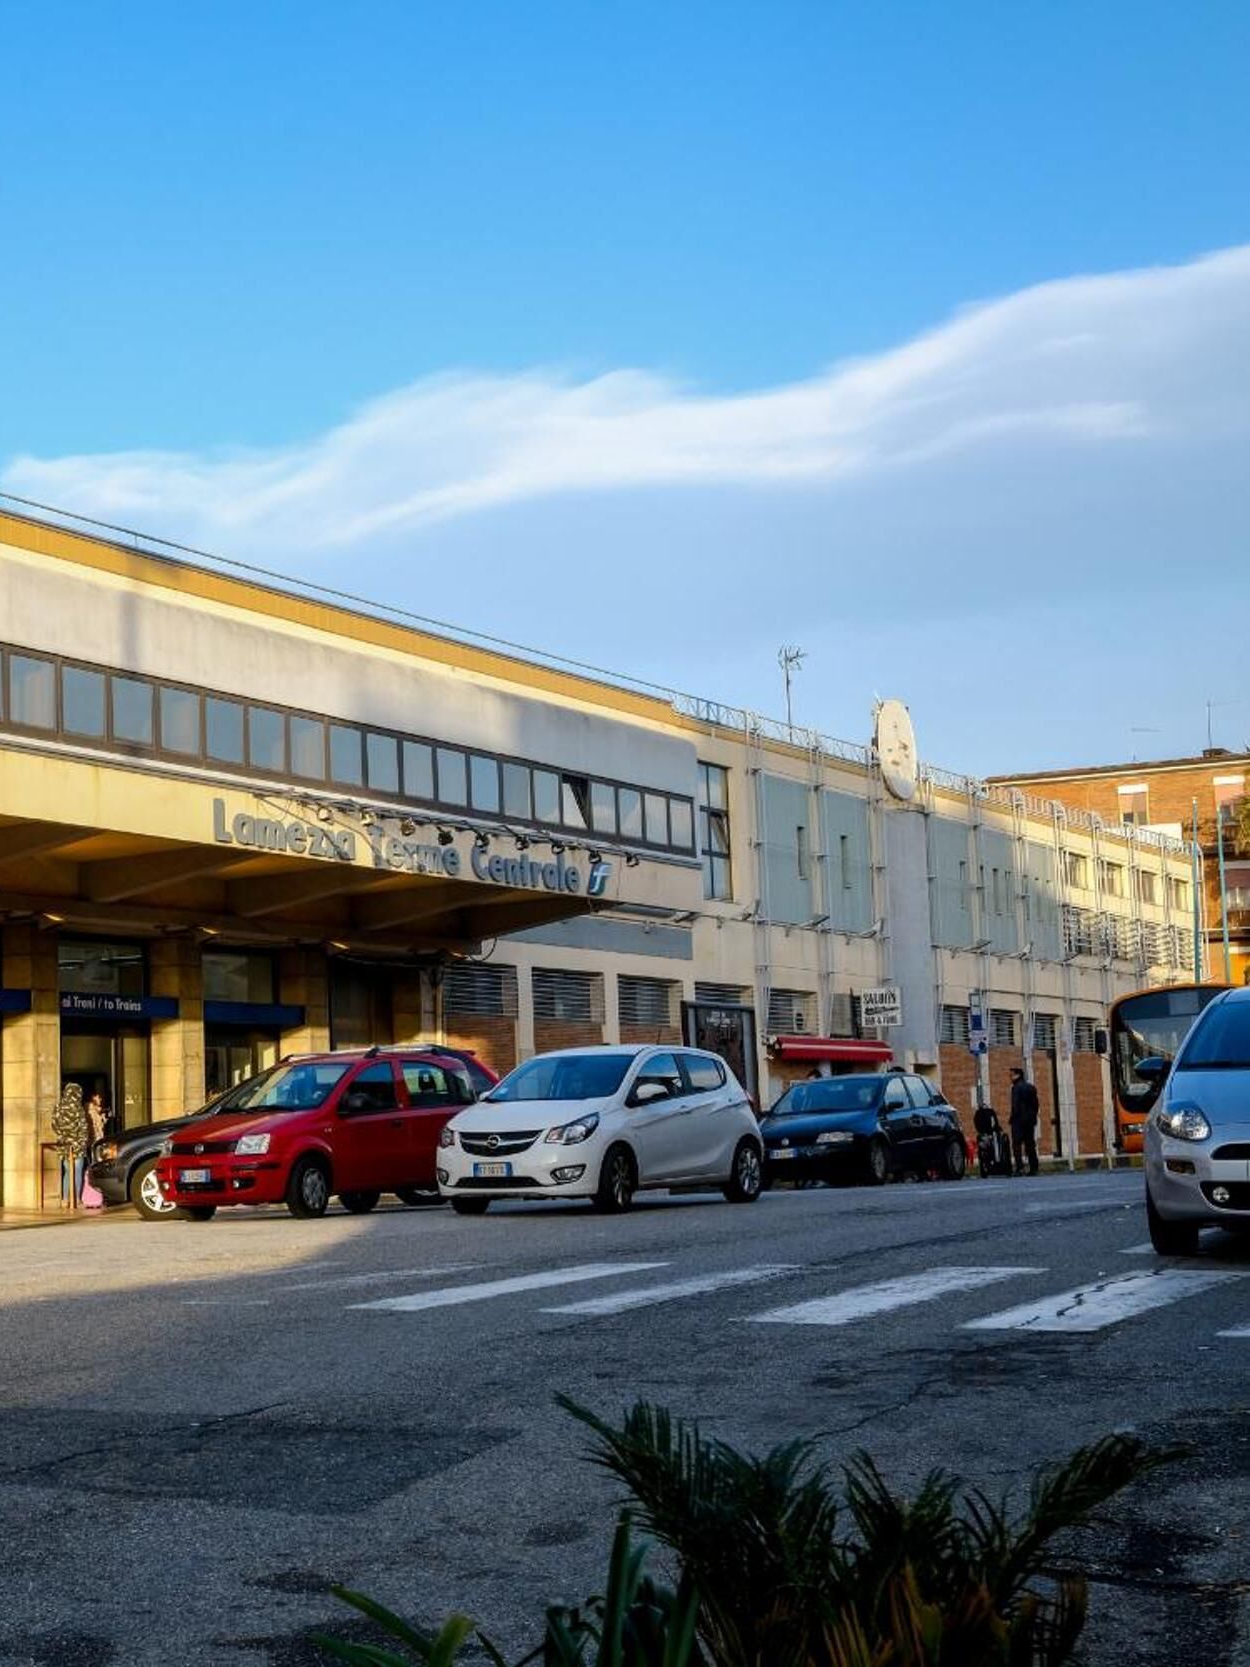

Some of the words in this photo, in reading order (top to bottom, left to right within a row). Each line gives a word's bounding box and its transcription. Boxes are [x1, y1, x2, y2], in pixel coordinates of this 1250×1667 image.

[213, 797, 356, 861] Lamezia
[367, 824, 461, 876] Terme
[471, 844, 580, 893] Centrale
[104, 997, 114, 1009] to
[115, 998, 142, 1011] Trains
